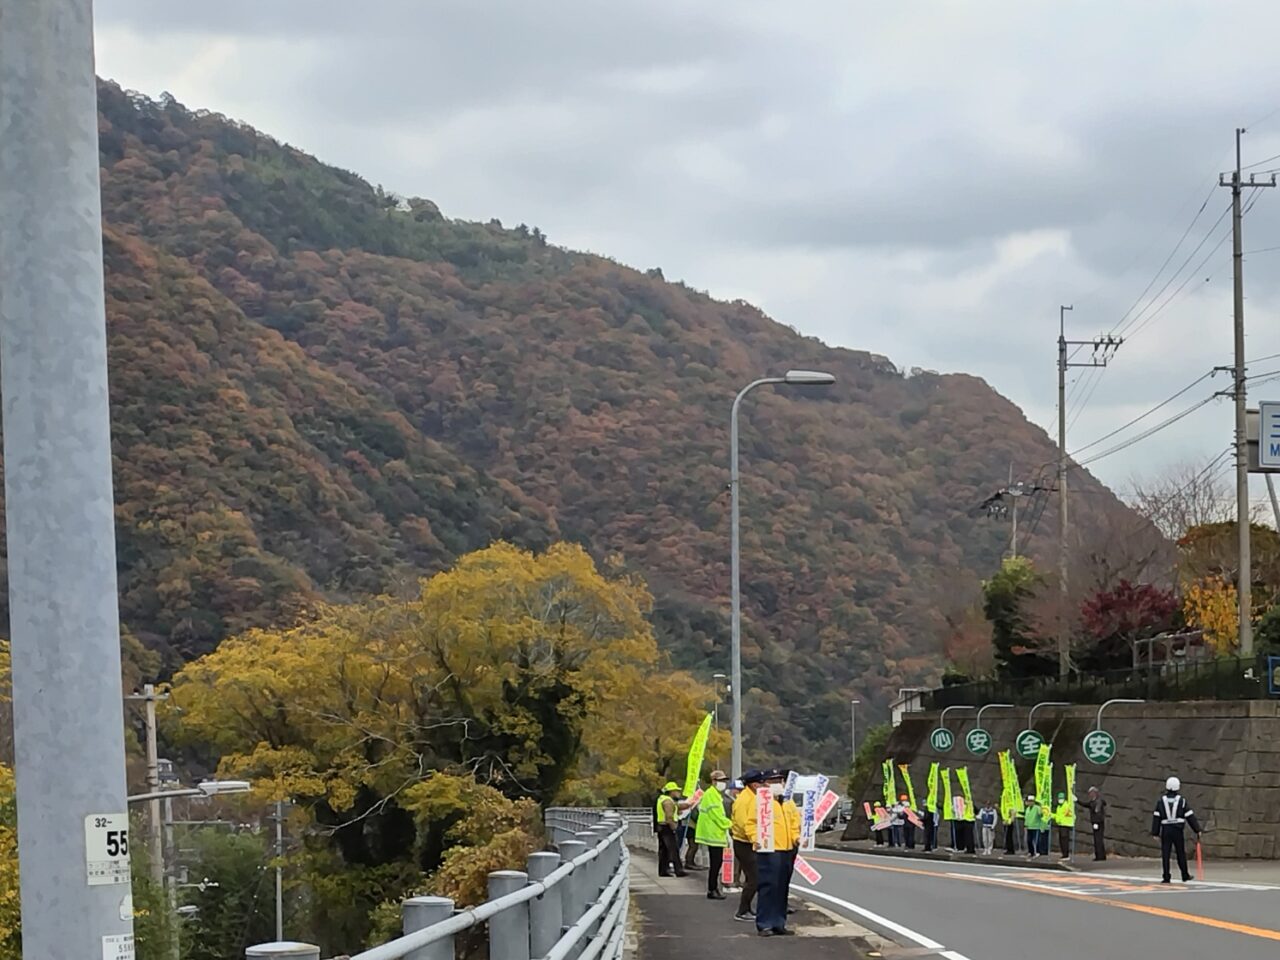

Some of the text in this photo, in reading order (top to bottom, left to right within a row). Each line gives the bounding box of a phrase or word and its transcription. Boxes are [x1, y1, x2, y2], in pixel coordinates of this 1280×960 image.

[935, 731, 951, 748] 心
[970, 733, 989, 751] 安
[1021, 734, 1042, 755] 全
[1088, 735, 1111, 758] 安
